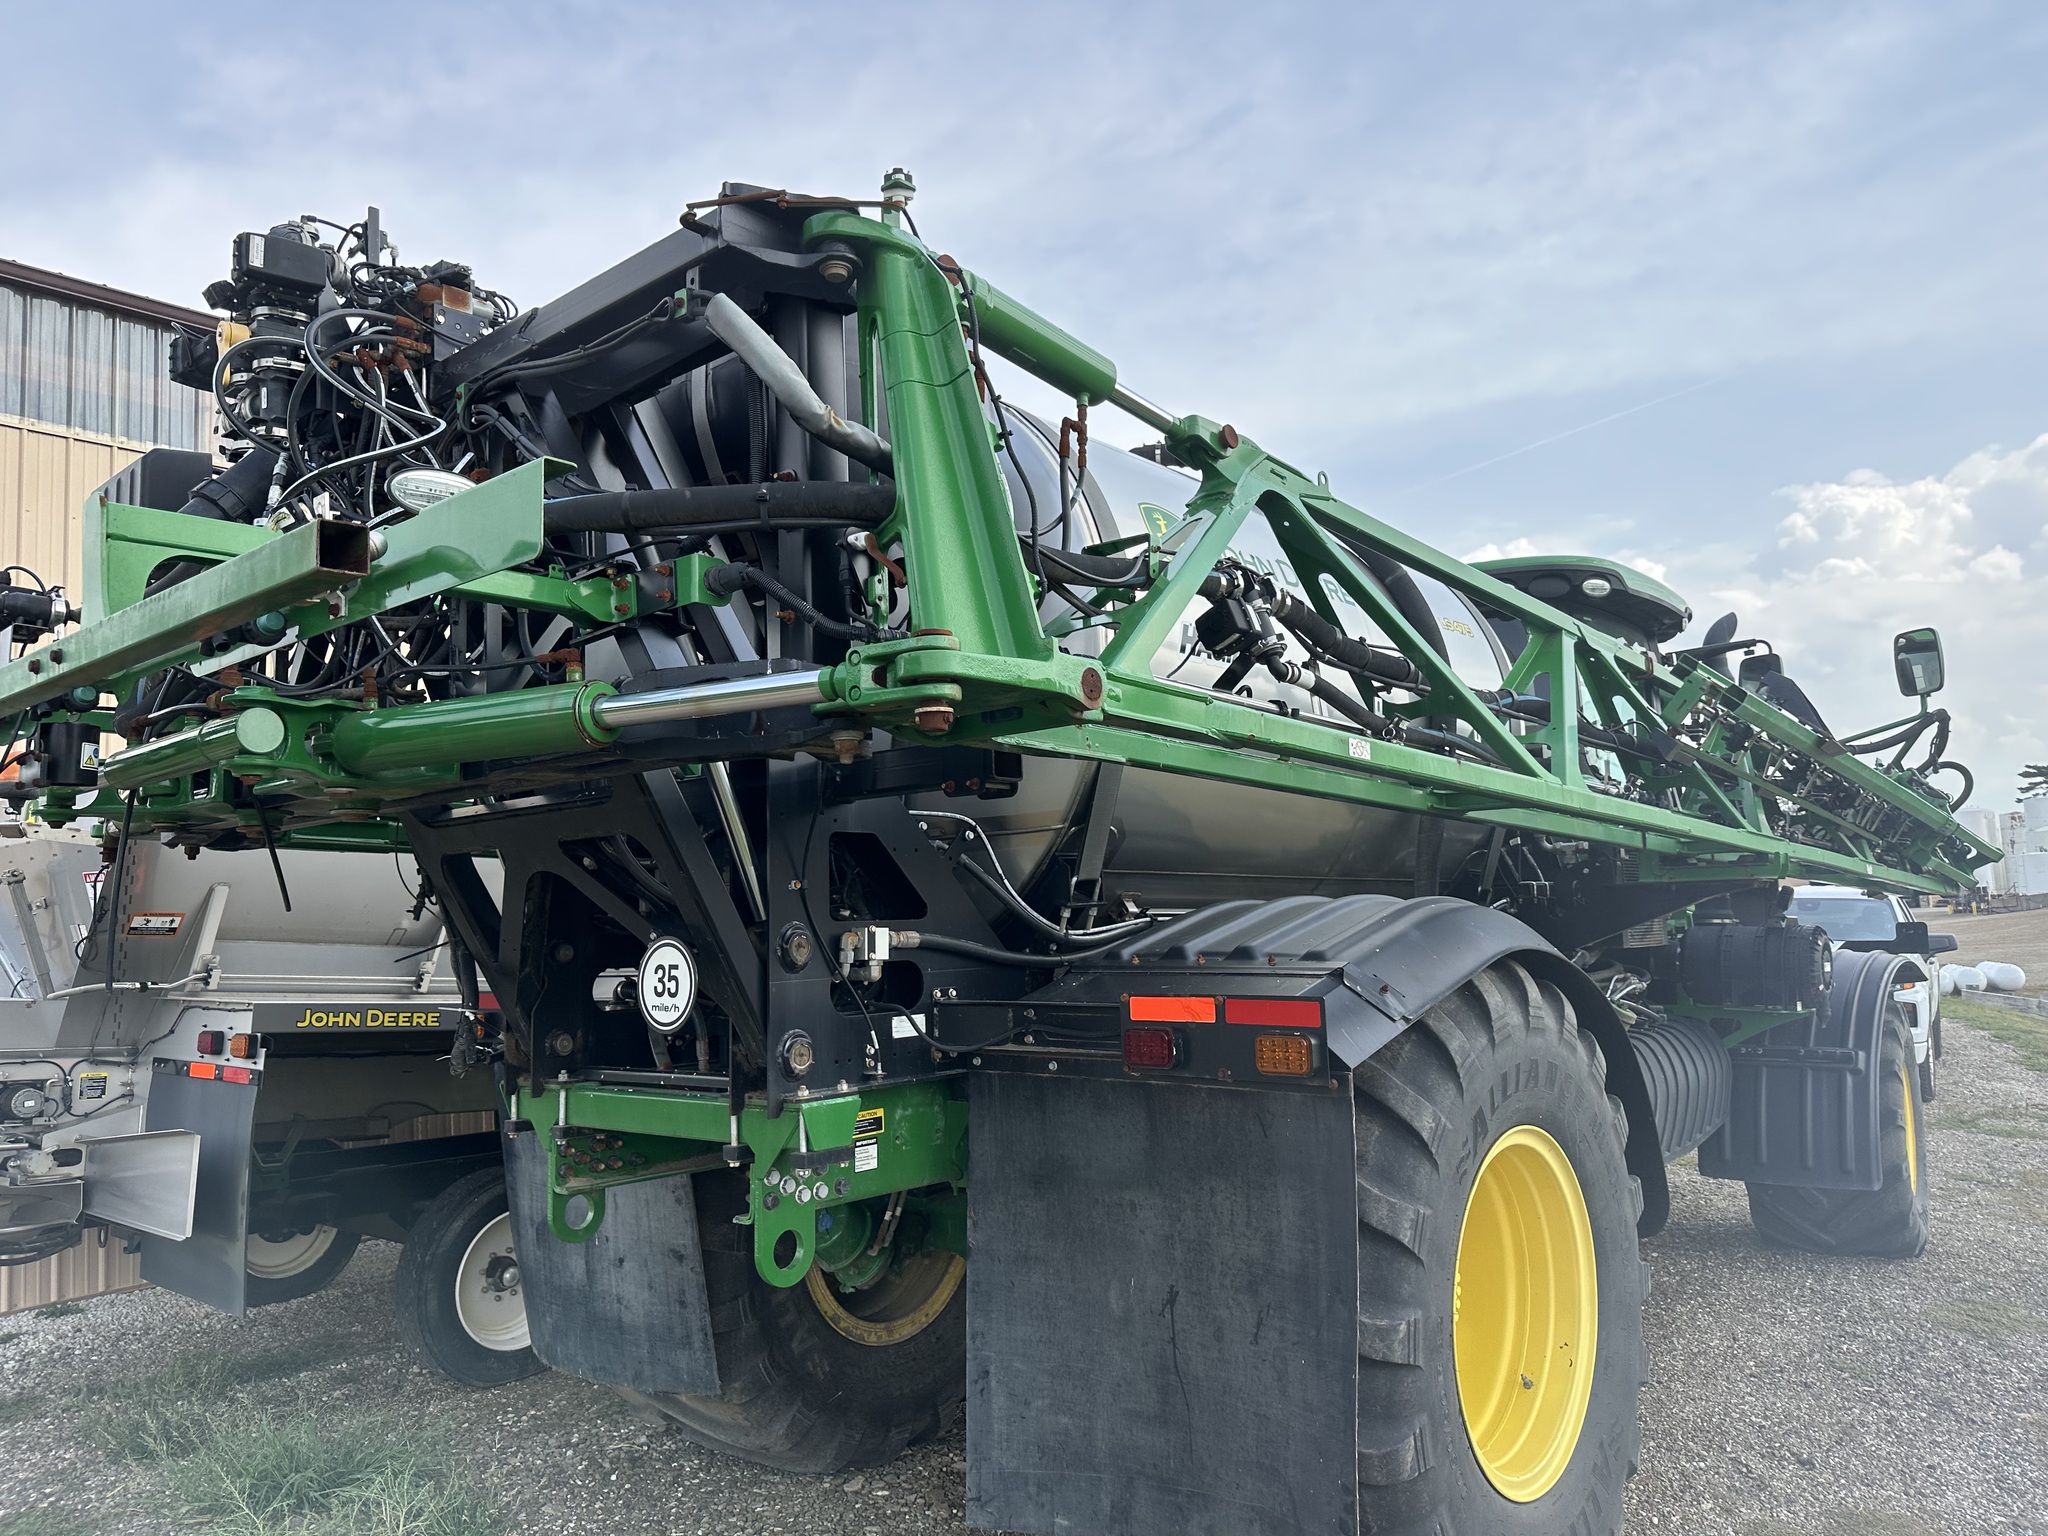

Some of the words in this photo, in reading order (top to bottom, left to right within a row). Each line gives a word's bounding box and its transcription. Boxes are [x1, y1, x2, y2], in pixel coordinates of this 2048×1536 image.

[653, 963, 679, 998] 35
[651, 1002, 680, 1013] mile/h
[296, 1008, 362, 1028] JOHN
[365, 1008, 441, 1028] DEERE
[857, 1110, 878, 1120] CAUTION
